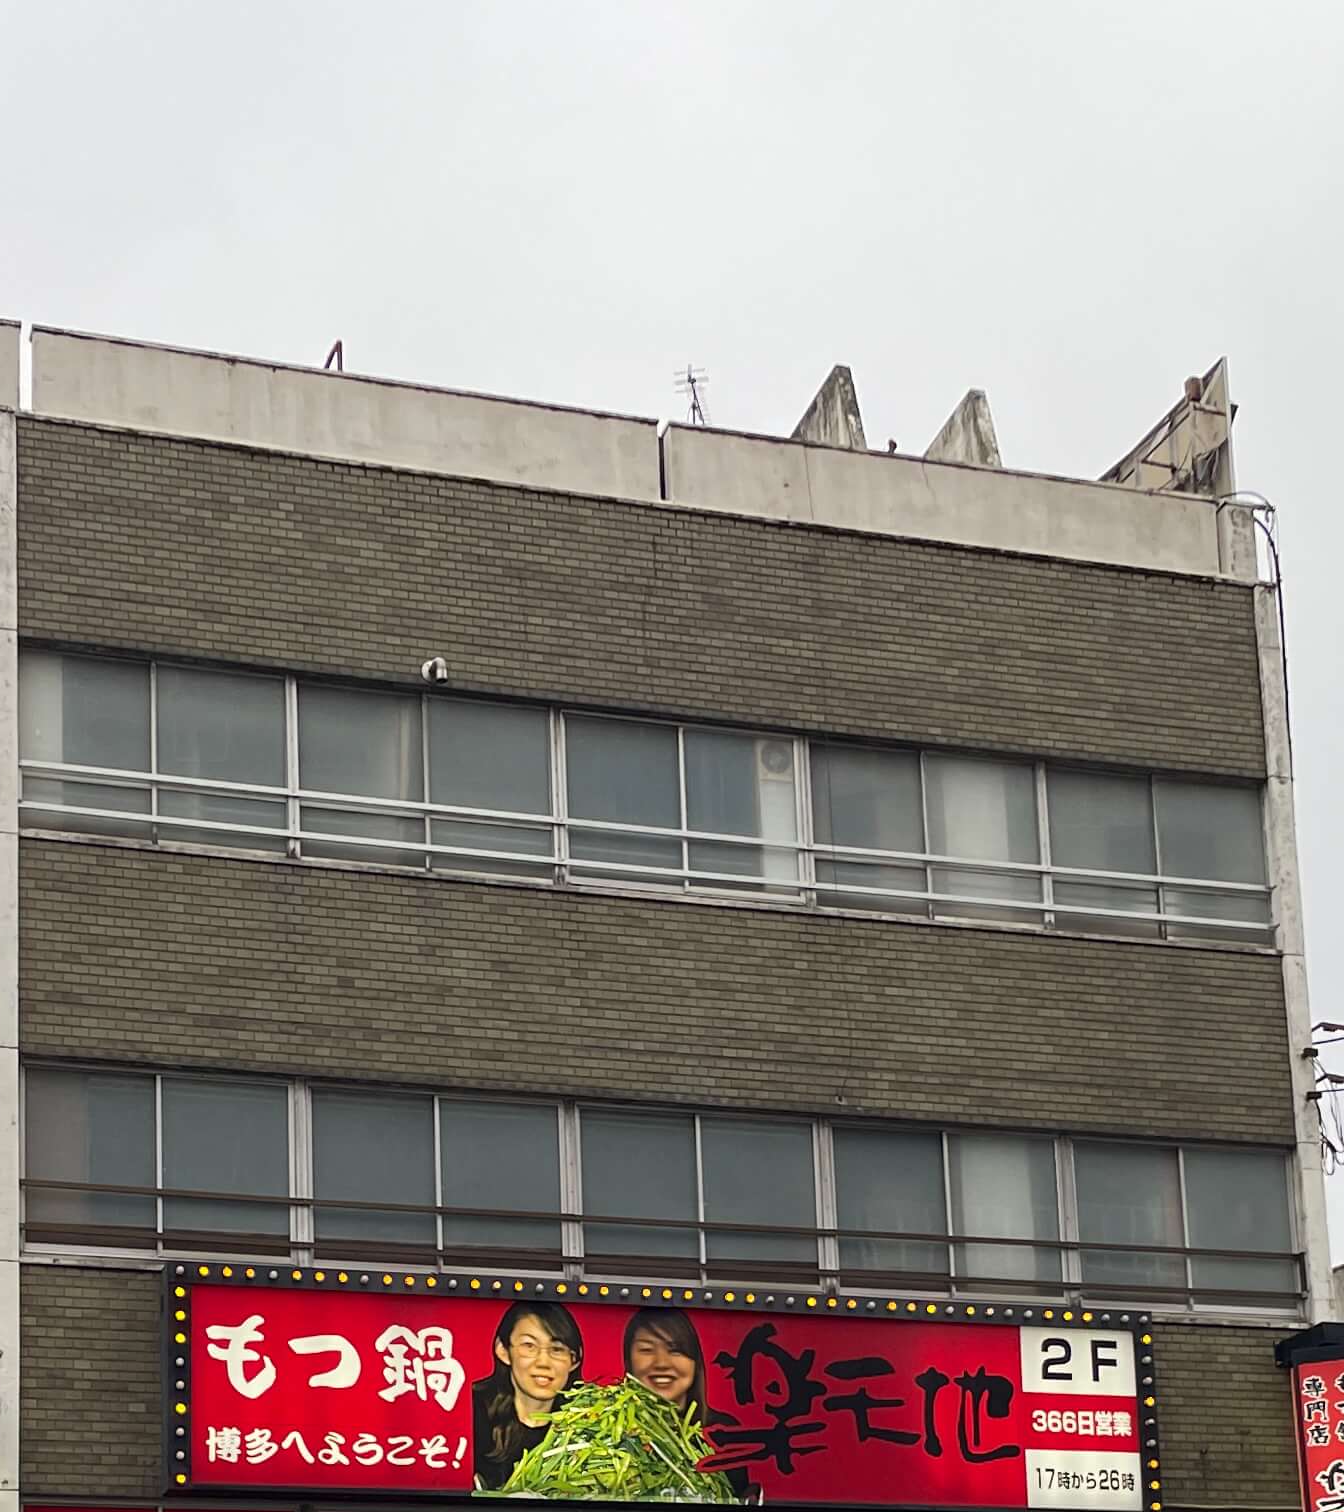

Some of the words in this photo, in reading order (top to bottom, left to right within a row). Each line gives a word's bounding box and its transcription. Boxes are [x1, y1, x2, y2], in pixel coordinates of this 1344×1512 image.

[205, 1313, 467, 1413] もつ鍋
[1040, 1338, 1120, 1383] 2F
[1031, 1408, 1133, 1438] 366日営業
[1303, 1376, 1331, 1446] 専門店
[205, 1426, 468, 1470] 博多へようこそ!
[1033, 1466, 1136, 1493] 17時から26時
